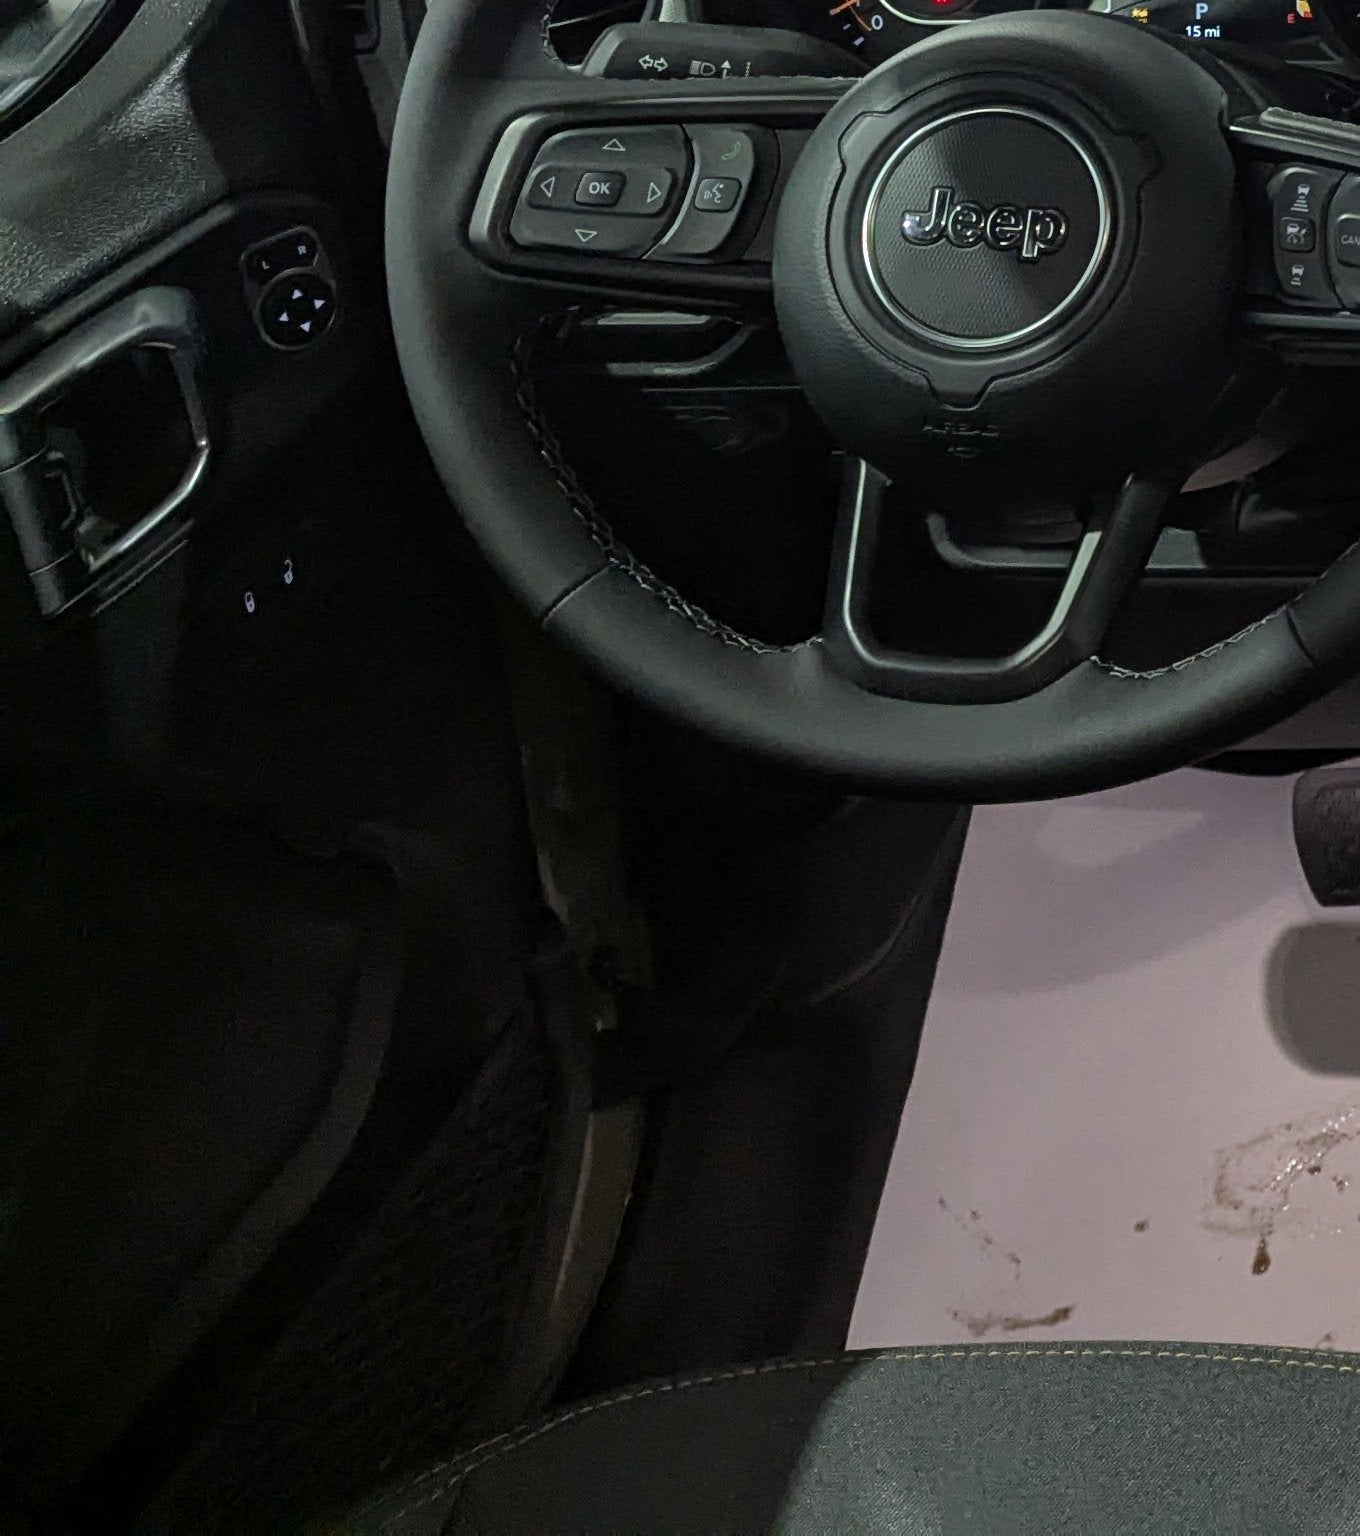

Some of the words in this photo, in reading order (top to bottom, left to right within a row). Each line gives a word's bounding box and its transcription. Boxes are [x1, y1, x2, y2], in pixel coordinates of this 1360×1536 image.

[1196, 3, 1208, 19] P
[870, 15, 884, 31] 0
[1287, 13, 1295, 23] E
[1186, 24, 1201, 38] 15
[1204, 24, 1220, 38] mi
[588, 182, 610, 195] OK
[902, 186, 1067, 262] Jeep
[298, 245, 308, 254] R
[262, 260, 270, 270] L
